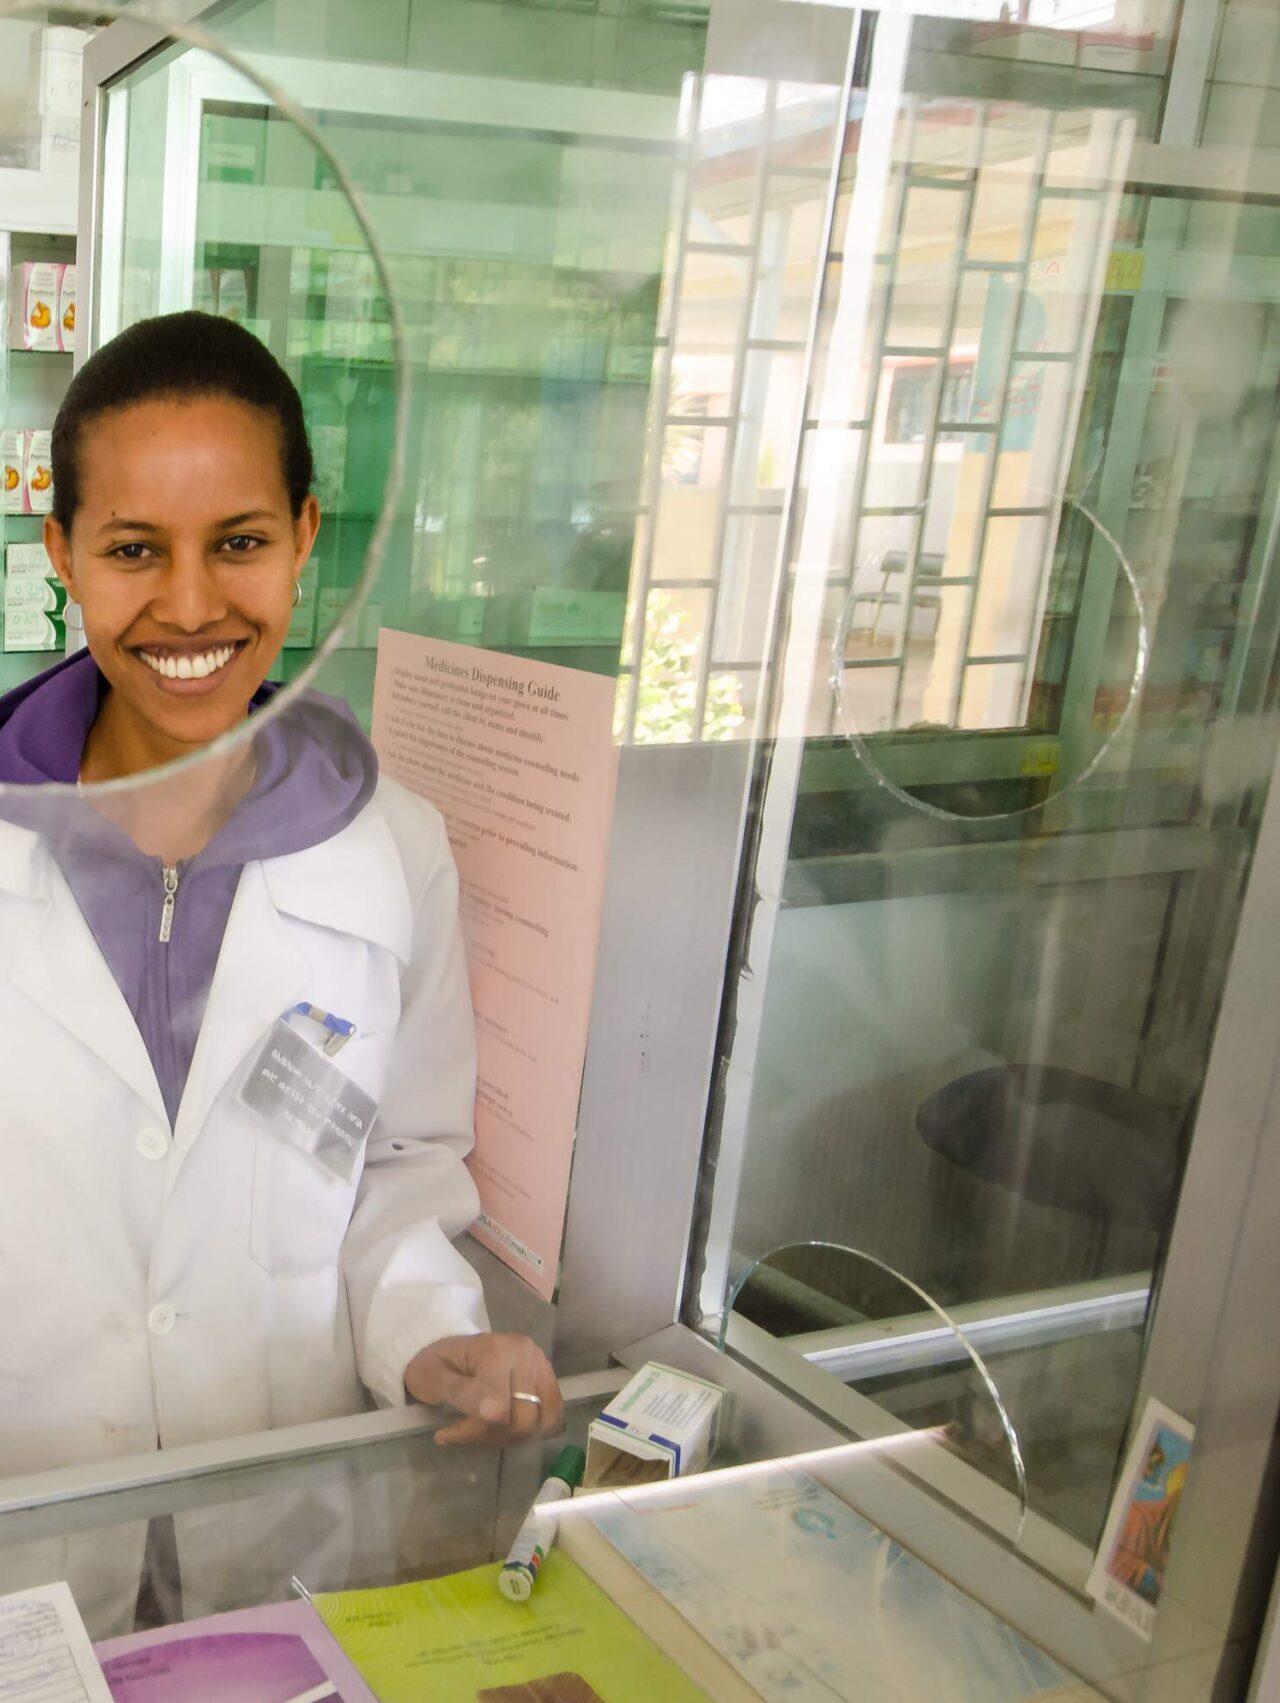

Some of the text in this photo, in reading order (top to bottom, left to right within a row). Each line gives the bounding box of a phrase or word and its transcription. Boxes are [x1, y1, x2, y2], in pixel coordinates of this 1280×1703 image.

[425, 655, 561, 702] Medicines Dispensing Guide
